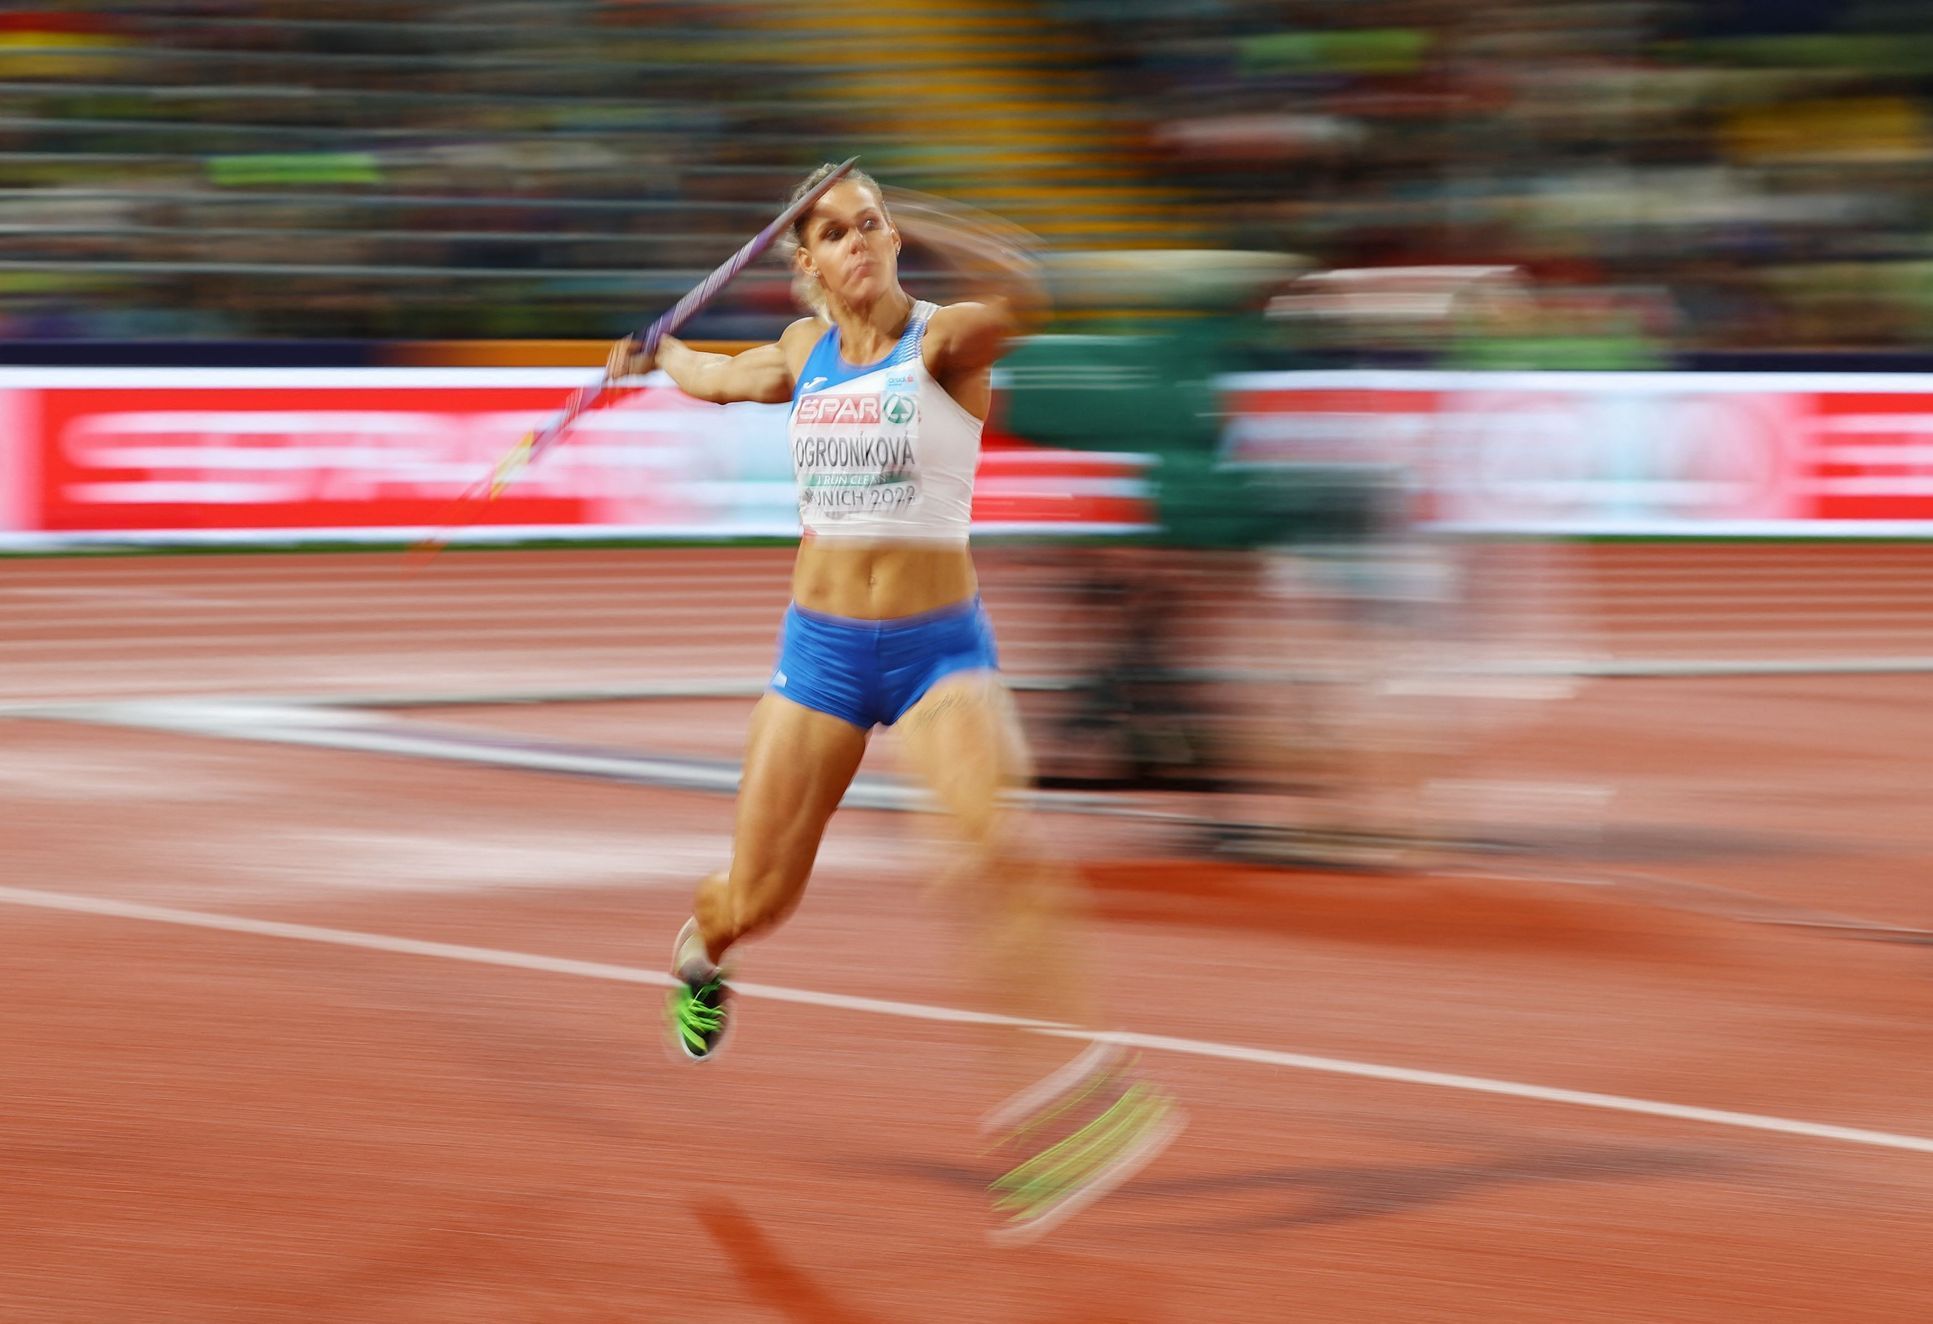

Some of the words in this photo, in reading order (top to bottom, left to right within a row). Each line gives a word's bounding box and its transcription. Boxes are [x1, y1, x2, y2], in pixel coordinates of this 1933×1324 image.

[799, 397, 878, 422] SPAR
[796, 431, 915, 467] OGRODNÍKOVÁ
[823, 475, 848, 485] RUN
[805, 490, 864, 507] UNICH
[871, 486, 915, 505] 2022
